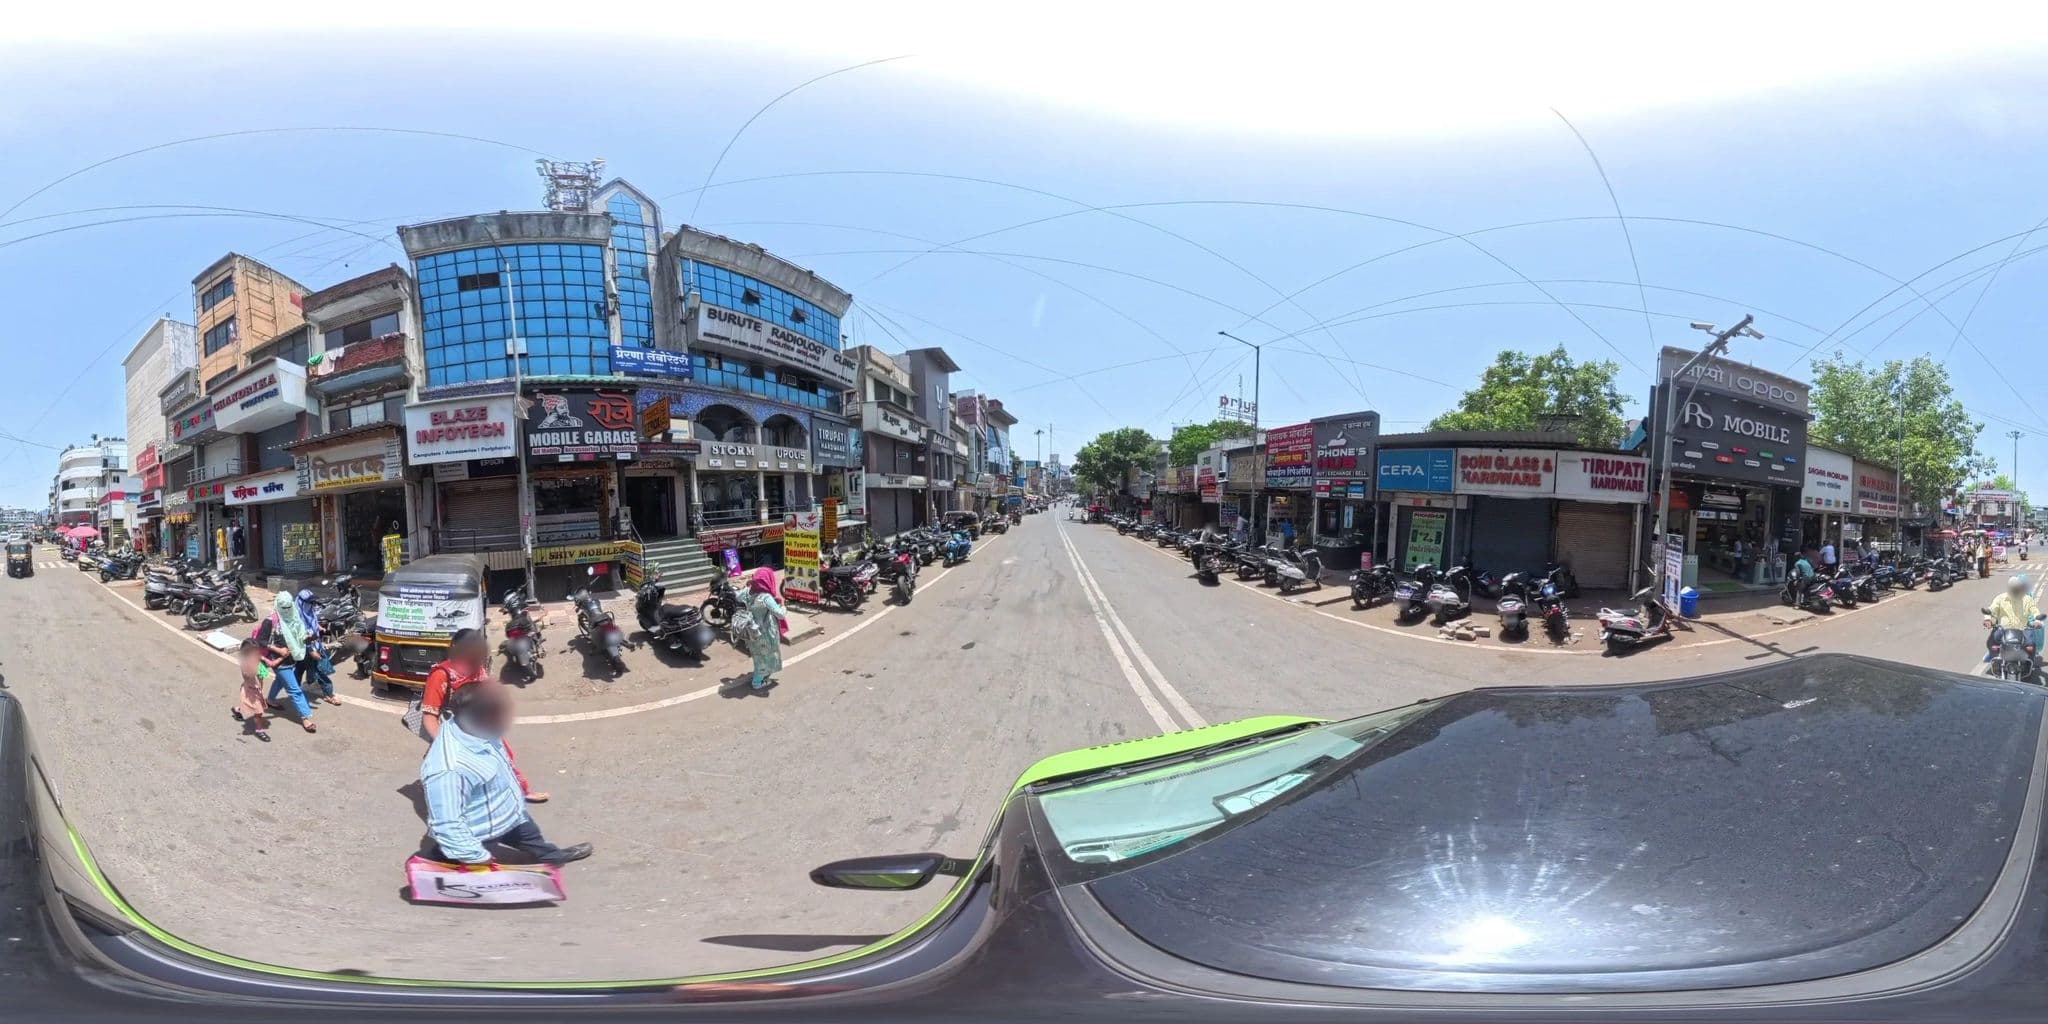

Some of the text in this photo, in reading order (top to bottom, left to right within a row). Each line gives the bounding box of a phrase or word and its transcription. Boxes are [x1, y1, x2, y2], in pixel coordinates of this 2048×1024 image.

[707, 308, 763, 333] BURUTE
[771, 327, 828, 357] RADIOLOGY
[833, 353, 857, 371] CLINIC
[431, 407, 488, 425] BLAZE
[416, 422, 505, 445] INFOTECH
[818, 428, 847, 444] TIRUPATI
[1723, 414, 1791, 445] MOBILE
[529, 431, 637, 447] MOBILE GARAGE
[1317, 447, 1367, 458] PHONE'S
[1380, 465, 1424, 475] CERA
[1494, 456, 1539, 471] GLASS
[1542, 457, 1552, 473] &
[1581, 458, 1646, 478] TIRUPATI
[1462, 471, 1542, 487] HARDWARE
[1591, 476, 1644, 492] HARDWARE
[549, 547, 625, 560] SHIV MOBILES
[786, 548, 818, 559] Repairing
[795, 542, 809, 550] Types
